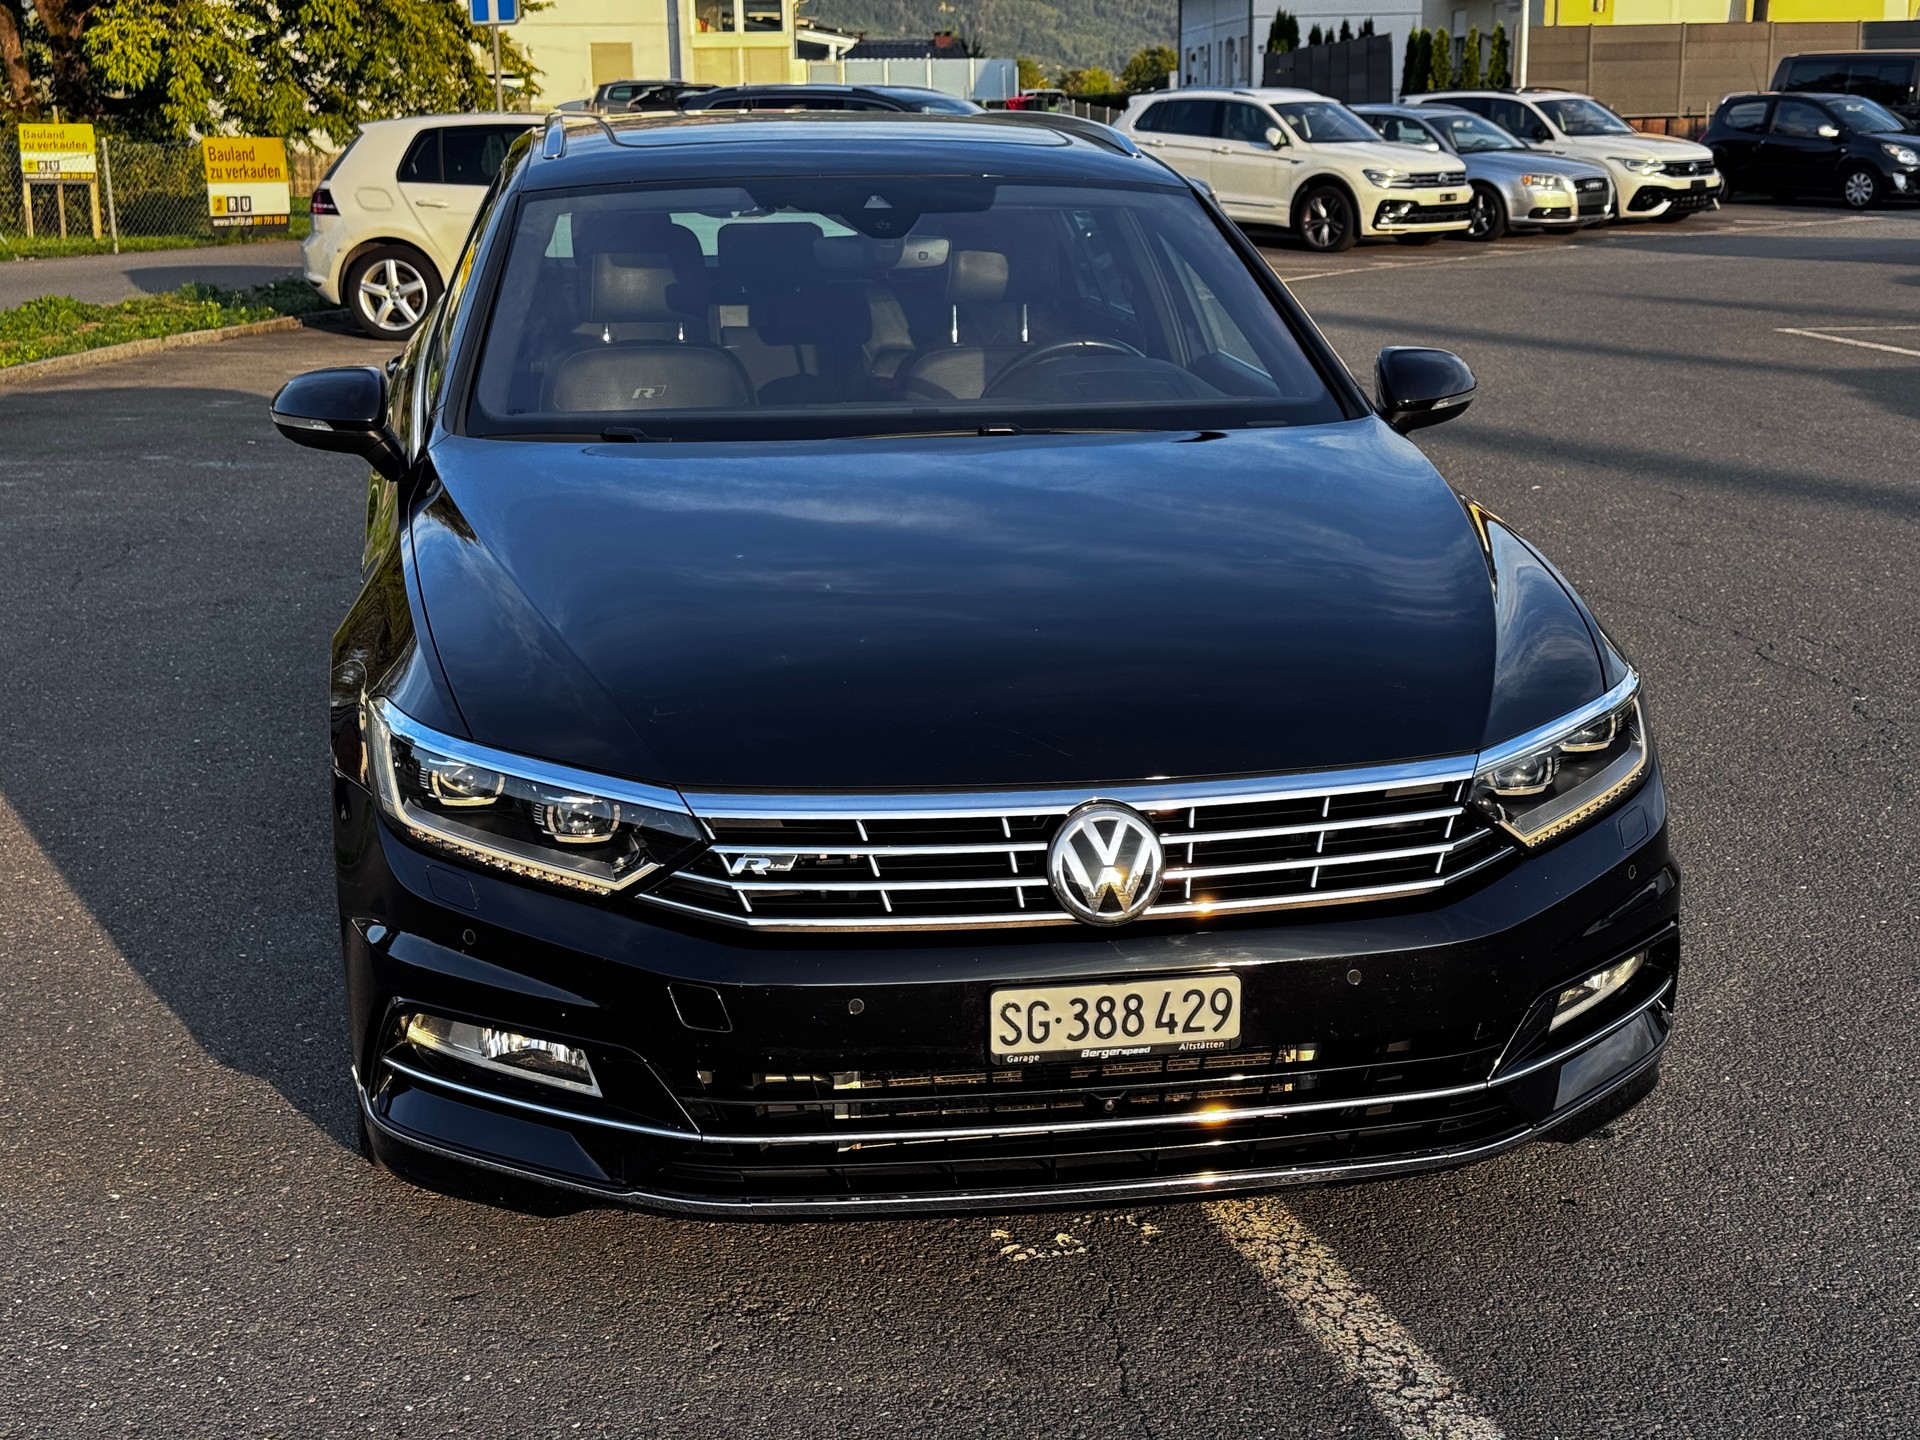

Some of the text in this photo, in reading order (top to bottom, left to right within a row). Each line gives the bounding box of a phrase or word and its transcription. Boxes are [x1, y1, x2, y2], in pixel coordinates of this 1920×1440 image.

[23, 130, 65, 139] Bauland
[23, 140, 88, 150] zu verkaufen
[207, 146, 256, 162] Bauland
[210, 163, 281, 179] zu verkaufen
[1006, 1040, 1225, 1064] Garage Bergerspeed Altstätten
